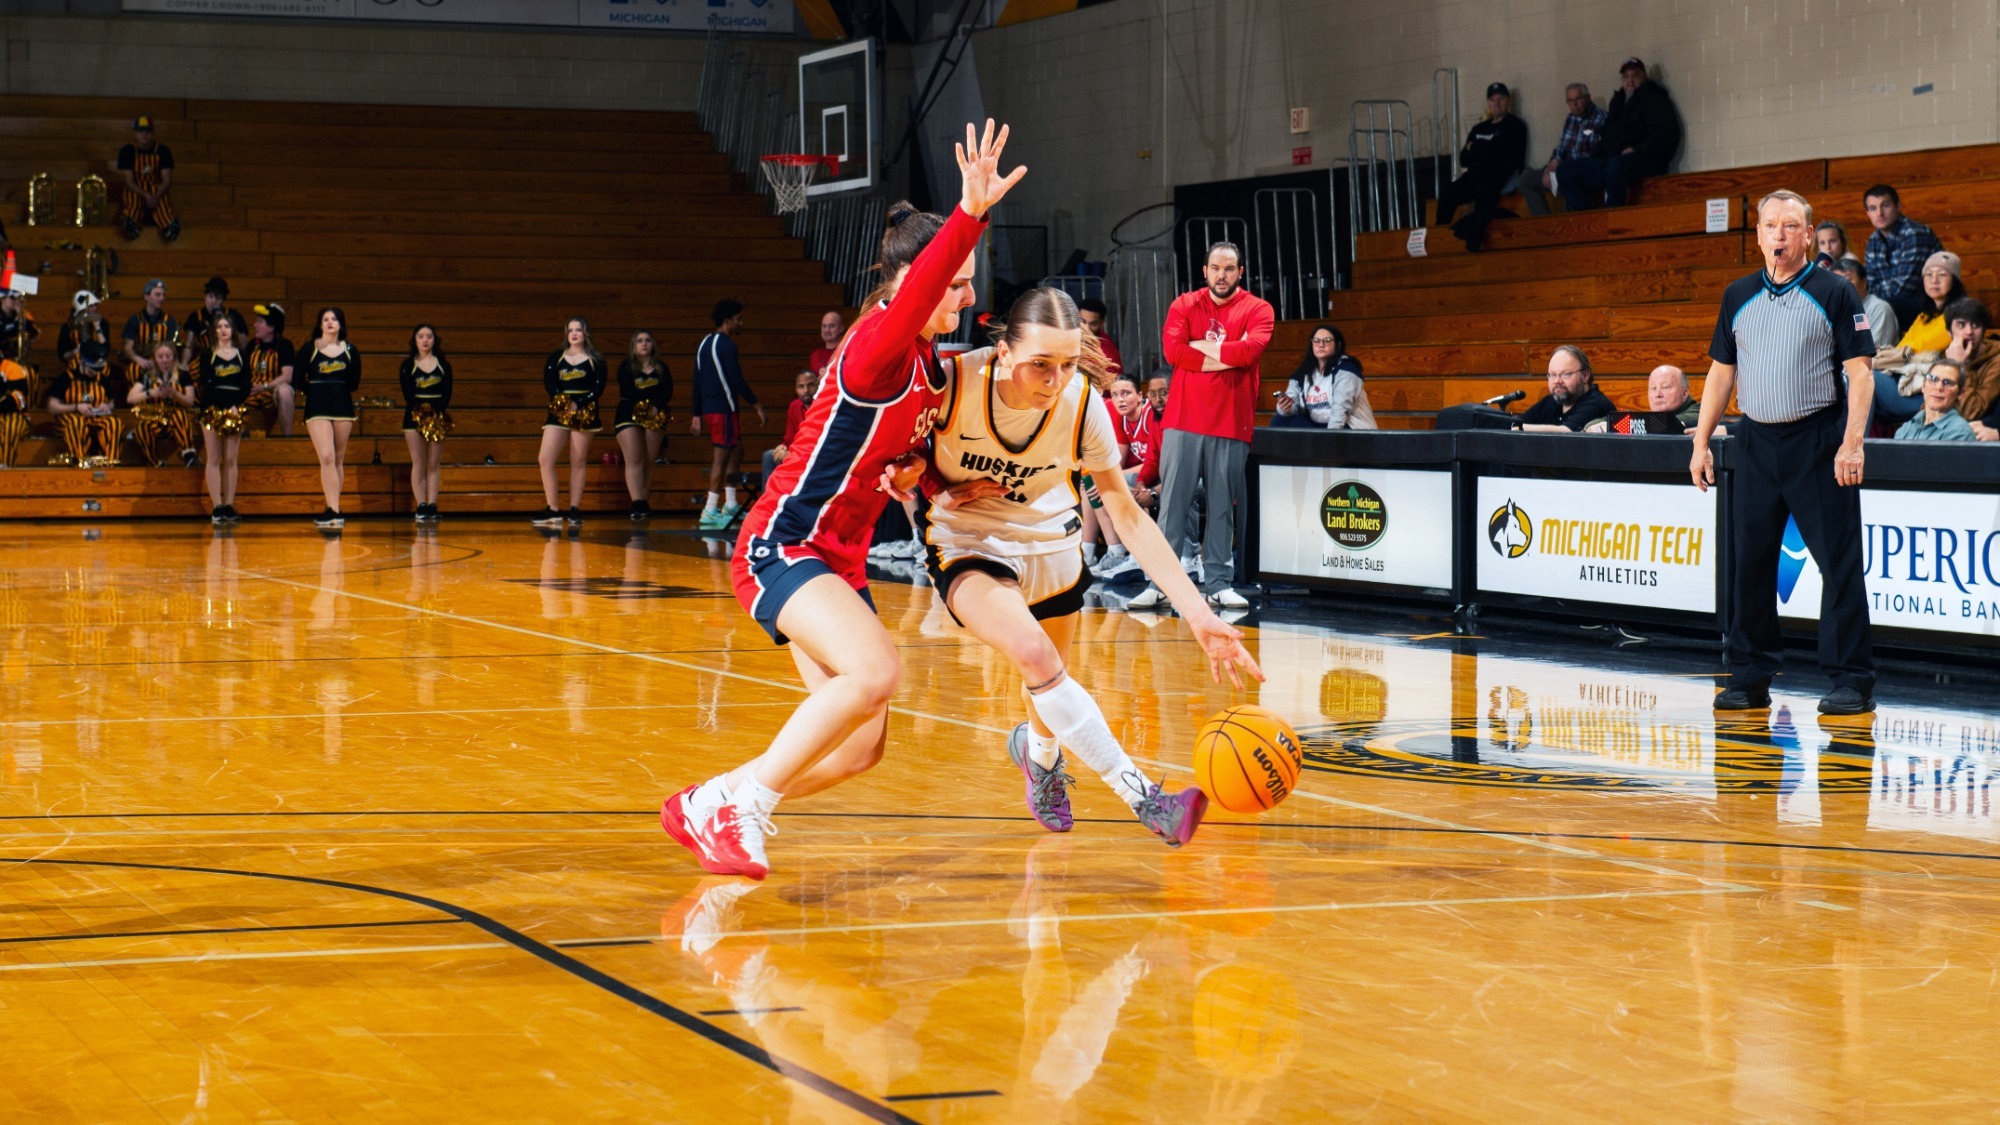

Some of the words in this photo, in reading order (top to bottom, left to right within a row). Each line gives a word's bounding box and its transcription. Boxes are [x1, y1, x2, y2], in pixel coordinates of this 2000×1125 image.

[609, 12, 670, 24] MICHIGAN
[707, 16, 766, 27] MICHIGAN
[960, 452, 1057, 478] HUSKIE
[1327, 496, 1351, 508] Northern
[1356, 497, 1380, 512] Michigan
[1327, 511, 1347, 529] Land
[1349, 513, 1380, 531] Brokers
[1539, 518, 1642, 561] MICHIGAN
[1648, 525, 1704, 566] TECH
[1339, 555, 1345, 568] &
[1579, 565, 1658, 587] ATHLETICS
[1868, 592, 1947, 616] TIONAL
[1253, 745, 1288, 805] Wilson
